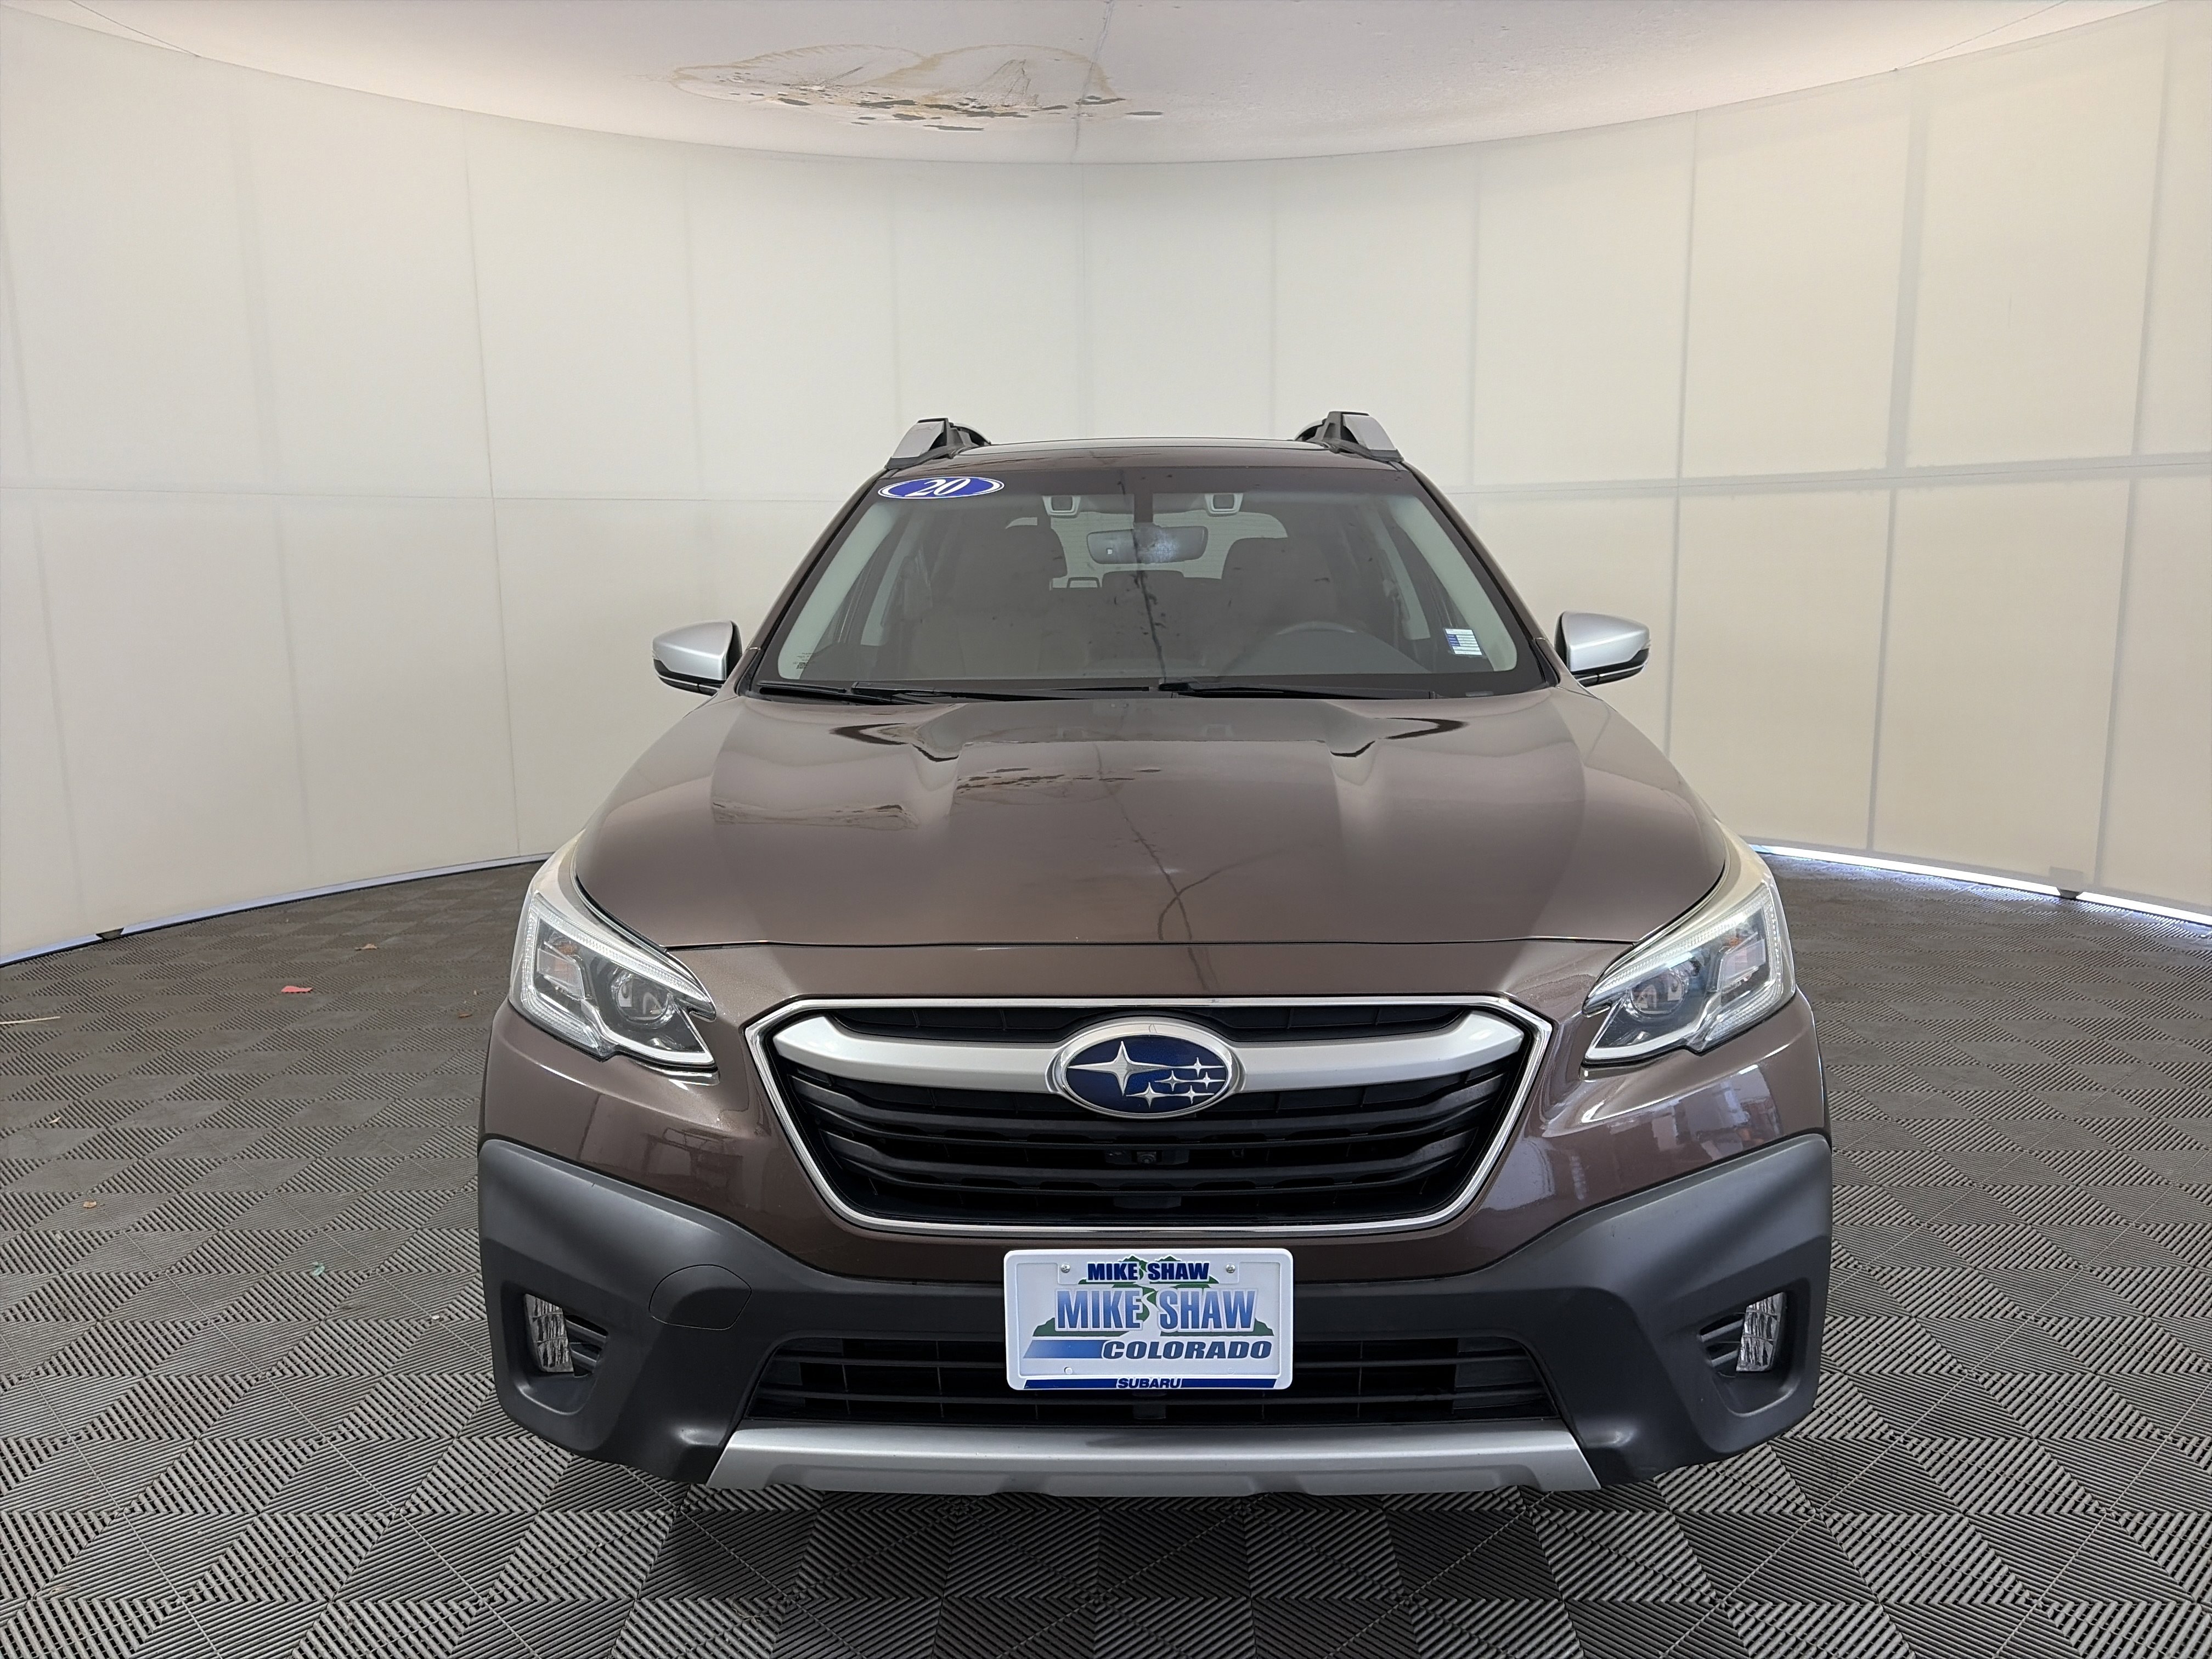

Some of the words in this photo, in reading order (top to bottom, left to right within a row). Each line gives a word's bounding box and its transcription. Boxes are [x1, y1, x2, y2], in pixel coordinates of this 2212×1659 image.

[905, 478, 971, 496] 20
[1087, 1263, 1138, 1280] MIKE
[1148, 1262, 1209, 1280] SHAW
[1057, 1290, 1141, 1328] MIKE
[1159, 1290, 1255, 1329] SHAW
[1103, 1341, 1272, 1359] COLORADO
[1118, 1378, 1181, 1388] SUBARU
